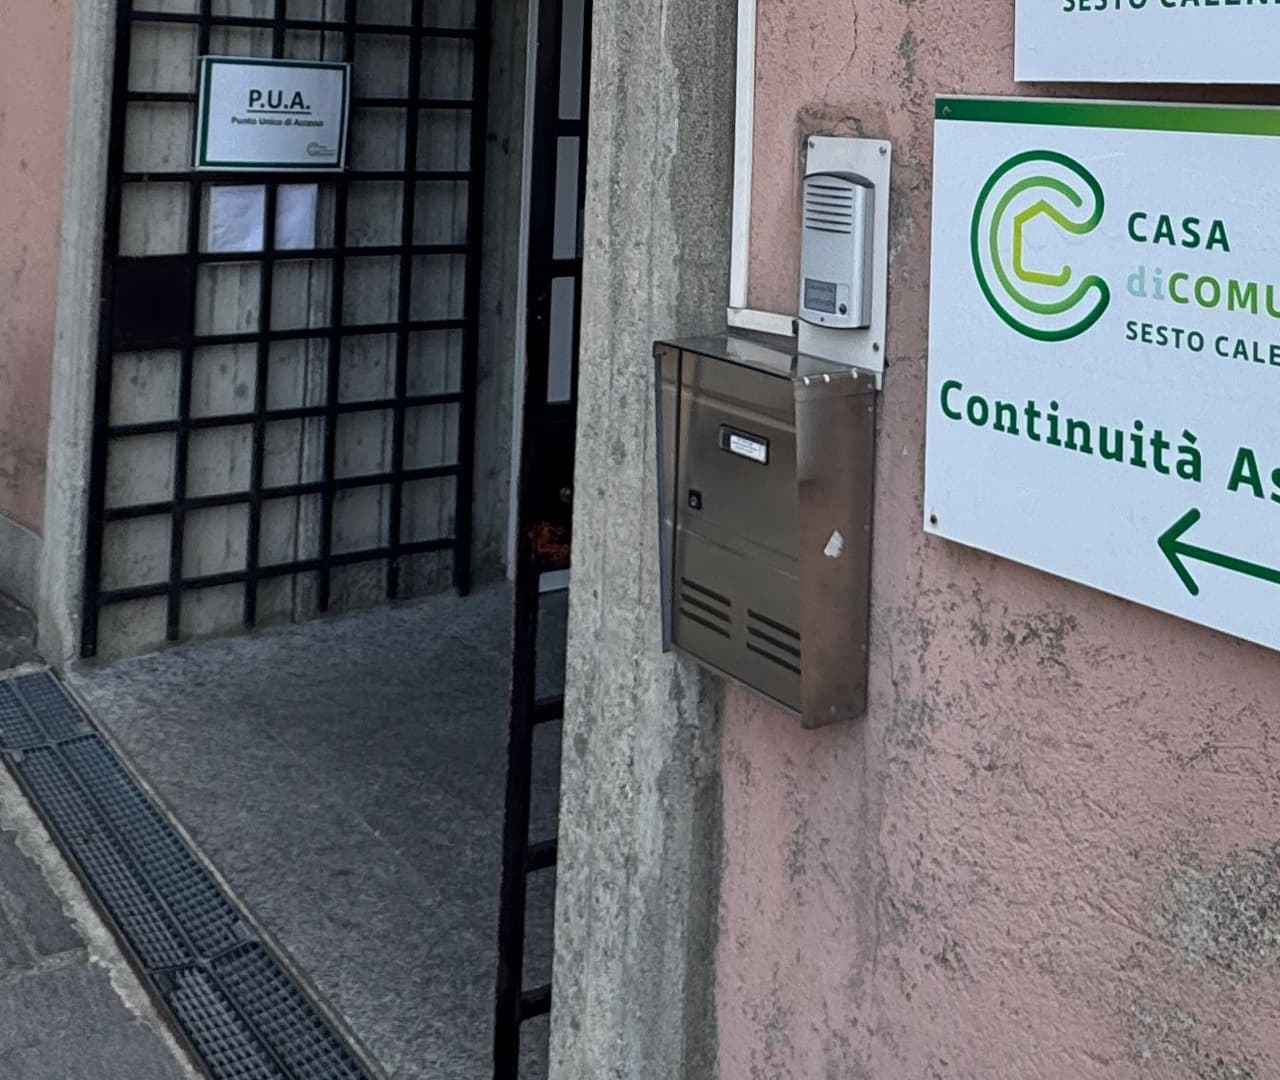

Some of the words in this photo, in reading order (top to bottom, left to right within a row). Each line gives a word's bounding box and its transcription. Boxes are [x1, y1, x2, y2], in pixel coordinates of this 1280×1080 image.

[248, 89, 311, 110] P.U.A.
[1127, 212, 1231, 253] CASA
[1126, 320, 1205, 352] SESTO
[939, 379, 1202, 482] Continuità
